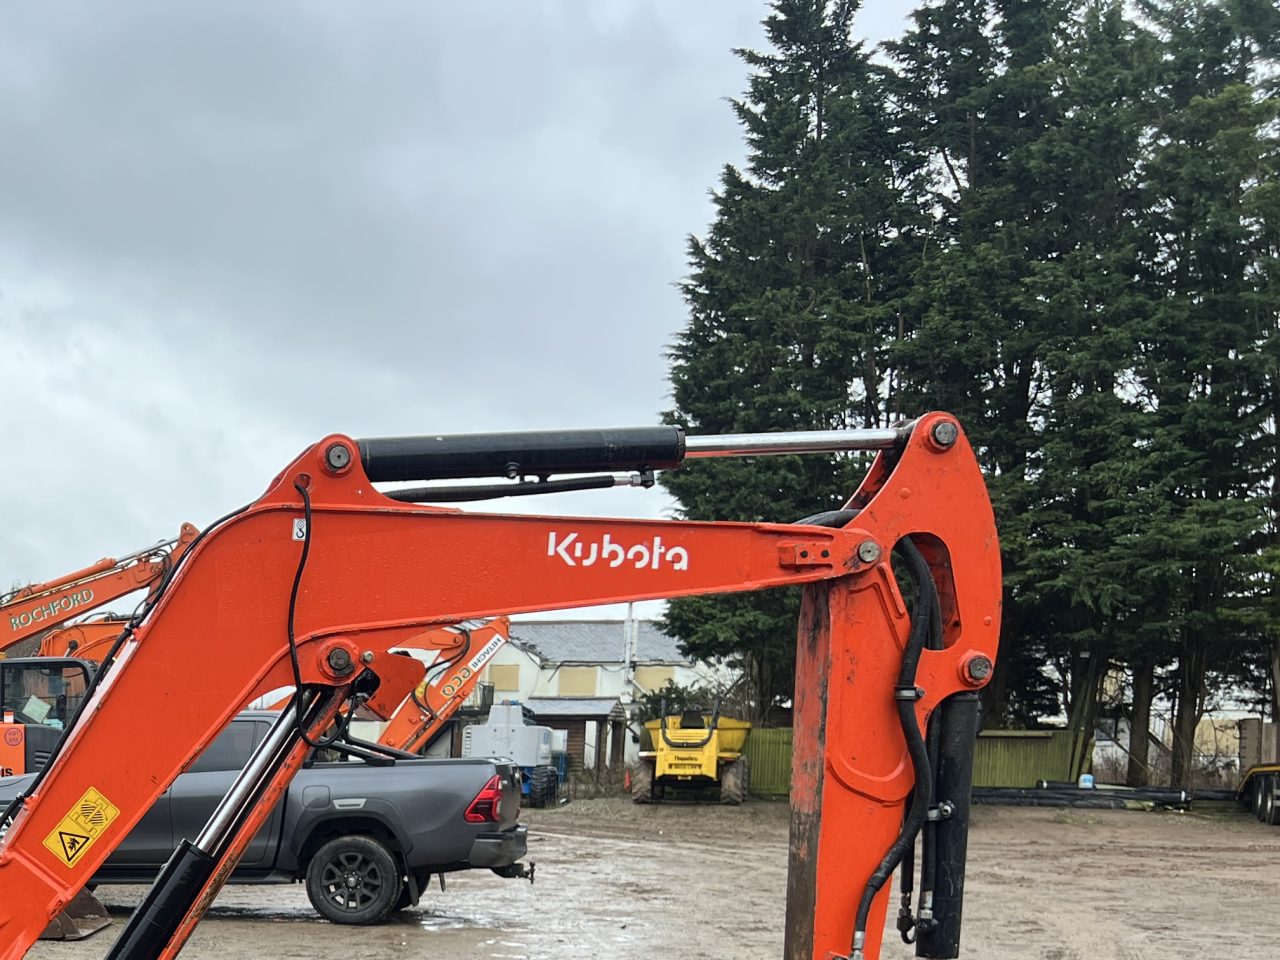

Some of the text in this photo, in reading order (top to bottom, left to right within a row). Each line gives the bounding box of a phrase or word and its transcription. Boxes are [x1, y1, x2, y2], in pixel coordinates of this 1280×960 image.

[547, 531, 688, 571] Kubota
[10, 588, 94, 631] ROCHFORD
[471, 637, 502, 669] HITACHI
